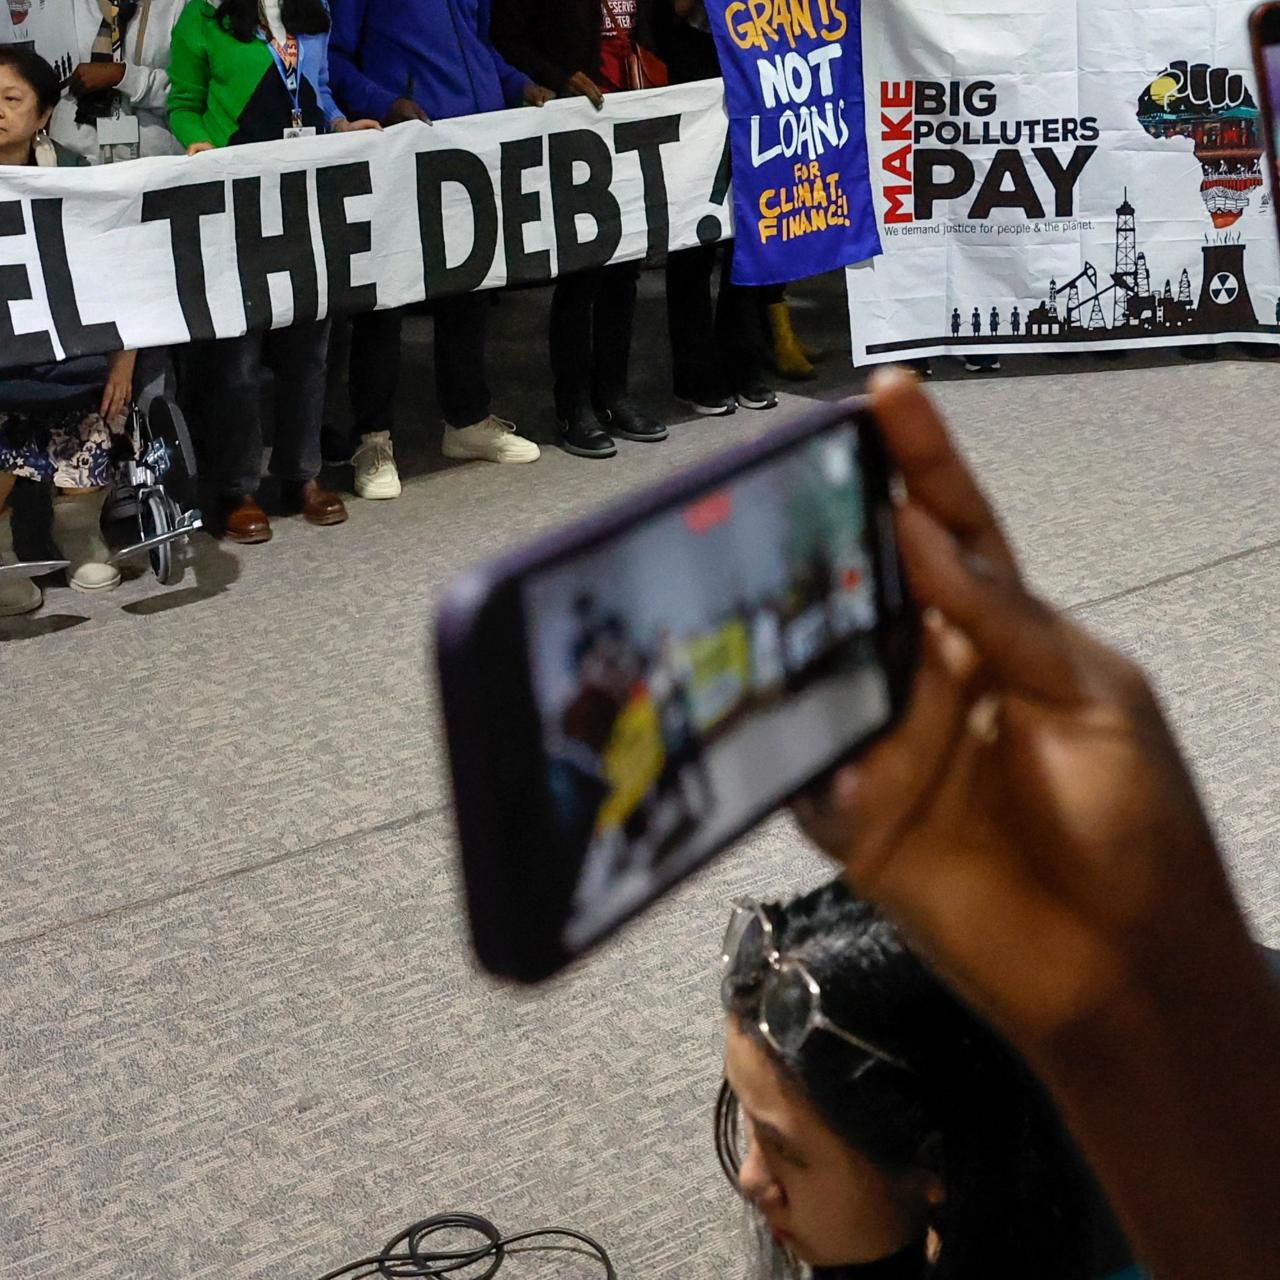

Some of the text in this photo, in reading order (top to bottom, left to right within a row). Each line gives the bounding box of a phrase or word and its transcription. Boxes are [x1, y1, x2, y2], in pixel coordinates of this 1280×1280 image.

[756, 42, 843, 109] NOT
[914, 80, 997, 116] BIG
[751, 98, 849, 168] LOANS
[880, 80, 913, 224] MAKE
[913, 116, 1100, 144] POLLUTERS
[794, 160, 820, 183] FOR
[913, 145, 1098, 220] PAY
[141, 160, 378, 341] THE
[415, 113, 733, 300] DEBT!
[884, 219, 1095, 237] We demand justice for people & the planet.
